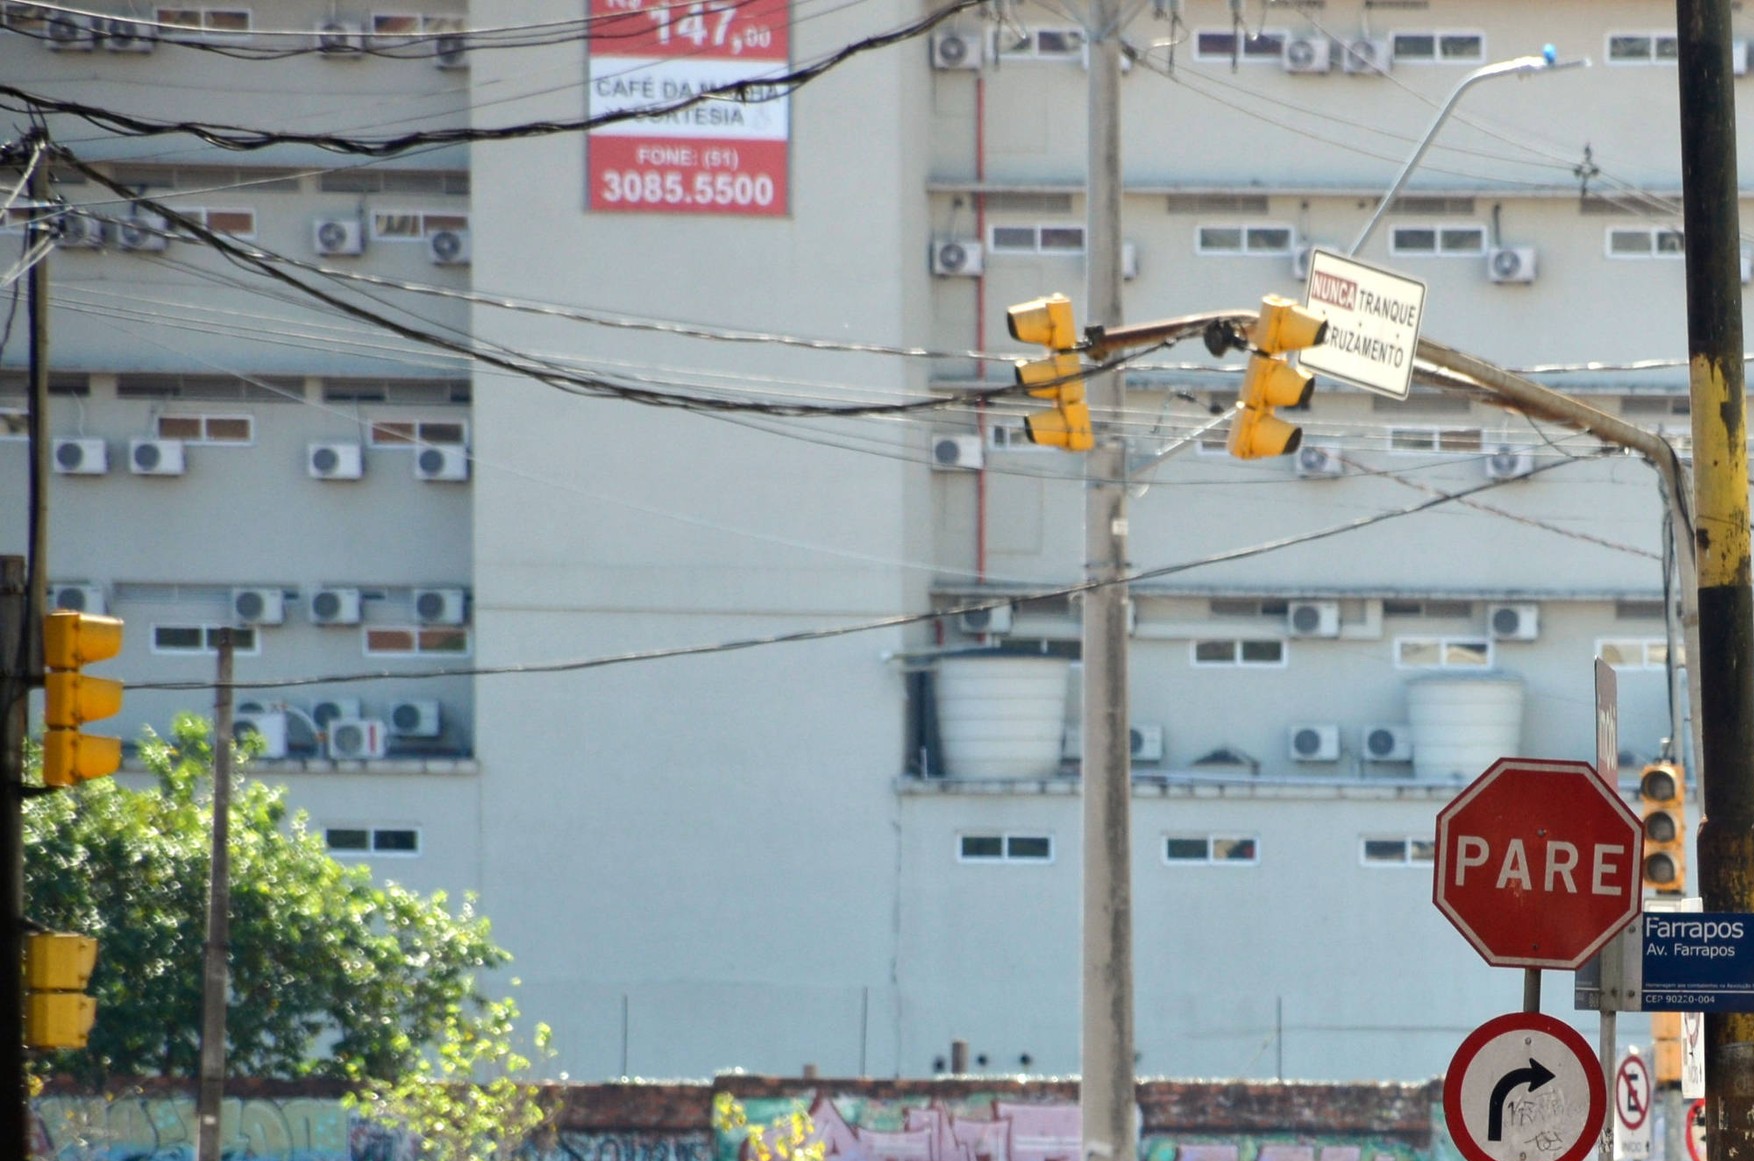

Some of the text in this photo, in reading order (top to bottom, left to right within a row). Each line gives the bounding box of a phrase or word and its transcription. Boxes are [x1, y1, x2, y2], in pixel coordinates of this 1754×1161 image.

[596, 77, 653, 98] CAFÉ
[662, 82, 694, 101] DA
[636, 146, 740, 171] FONE: (51)
[602, 170, 775, 206] 3085.5500
[1311, 273, 1416, 328] NUNCA TRANQUE
[1455, 835, 1625, 896] PARE
[1645, 917, 1744, 943] Farrapos
[1646, 943, 1735, 959] Av. Farrapos
